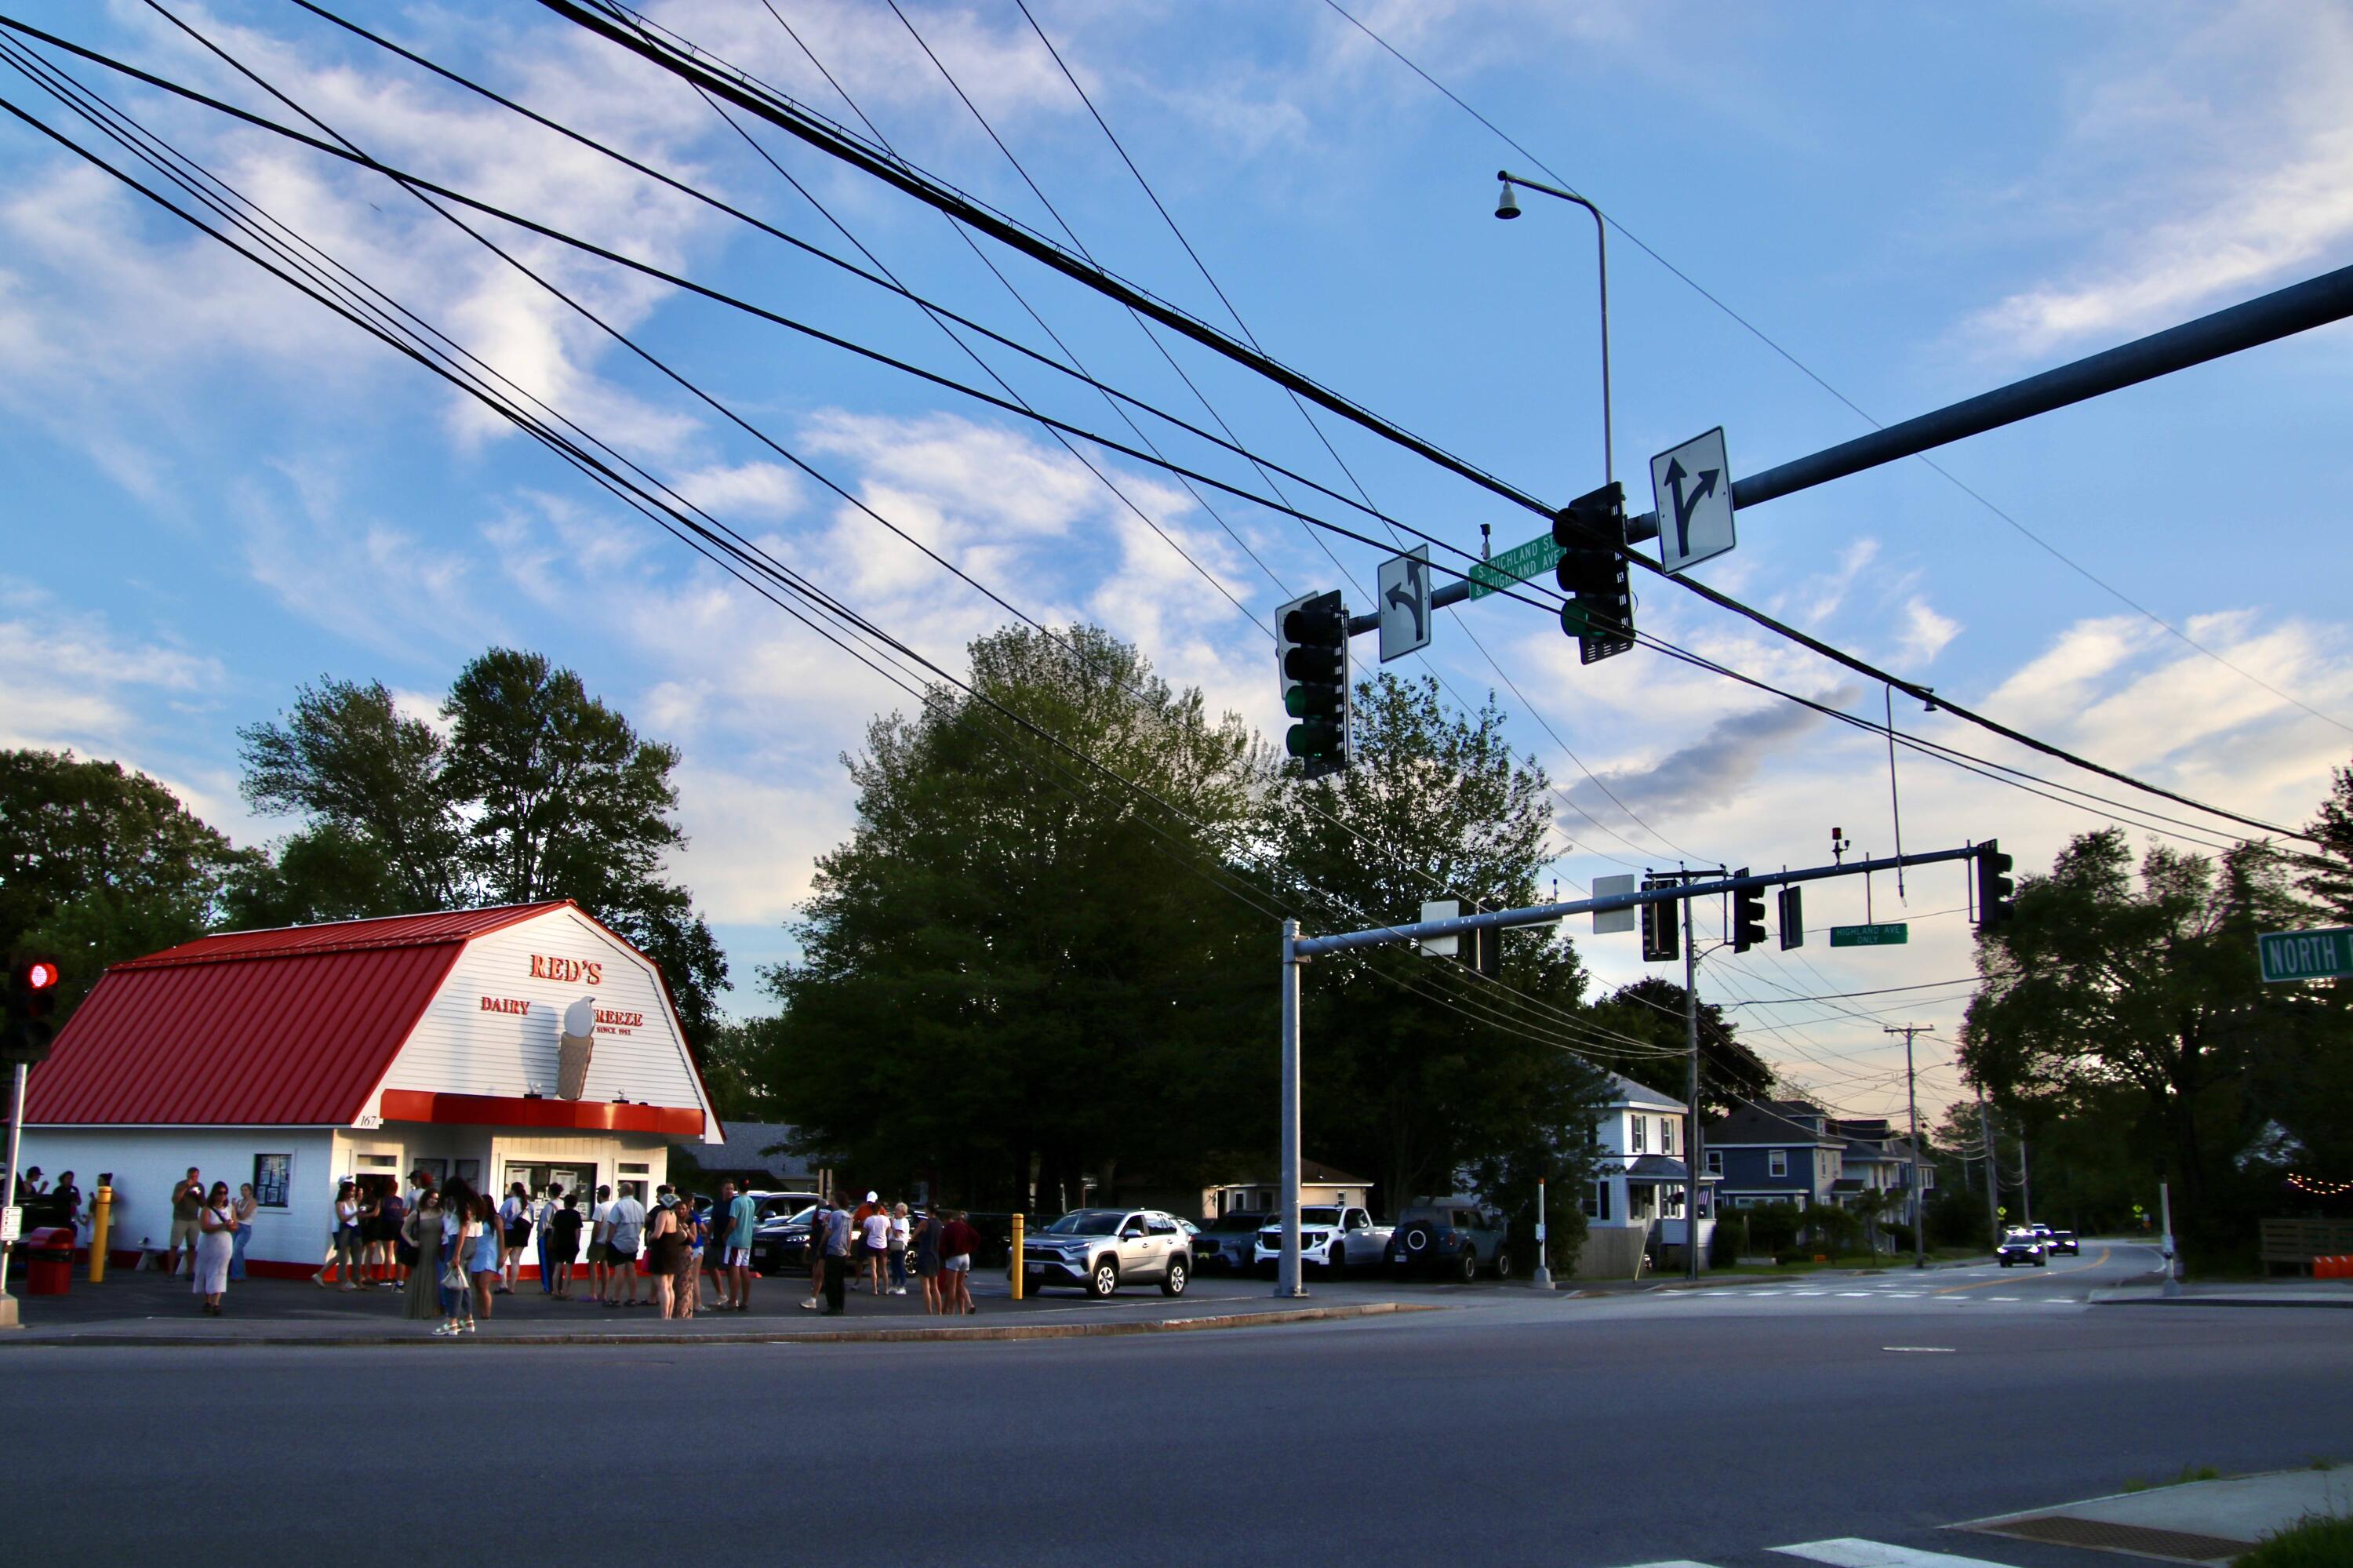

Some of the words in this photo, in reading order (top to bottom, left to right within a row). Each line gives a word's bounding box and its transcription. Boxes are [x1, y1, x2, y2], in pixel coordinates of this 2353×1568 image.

[1478, 566, 1486, 579] S.
[1490, 543, 1537, 574] RICHLAND
[1475, 584, 1483, 596] &
[1488, 560, 1537, 591] HIGHLAND
[1837, 926, 1879, 937] HIGHLAND
[1884, 925, 1900, 934] AVE
[1857, 935, 1879, 944] ONLY
[529, 954, 602, 985] RED'S
[2268, 935, 2338, 974] NORTH
[481, 996, 530, 1015] DAIRY
[594, 1009, 643, 1027] REEZE
[596, 1026, 616, 1035] SINCE
[361, 1115, 376, 1126] 167
